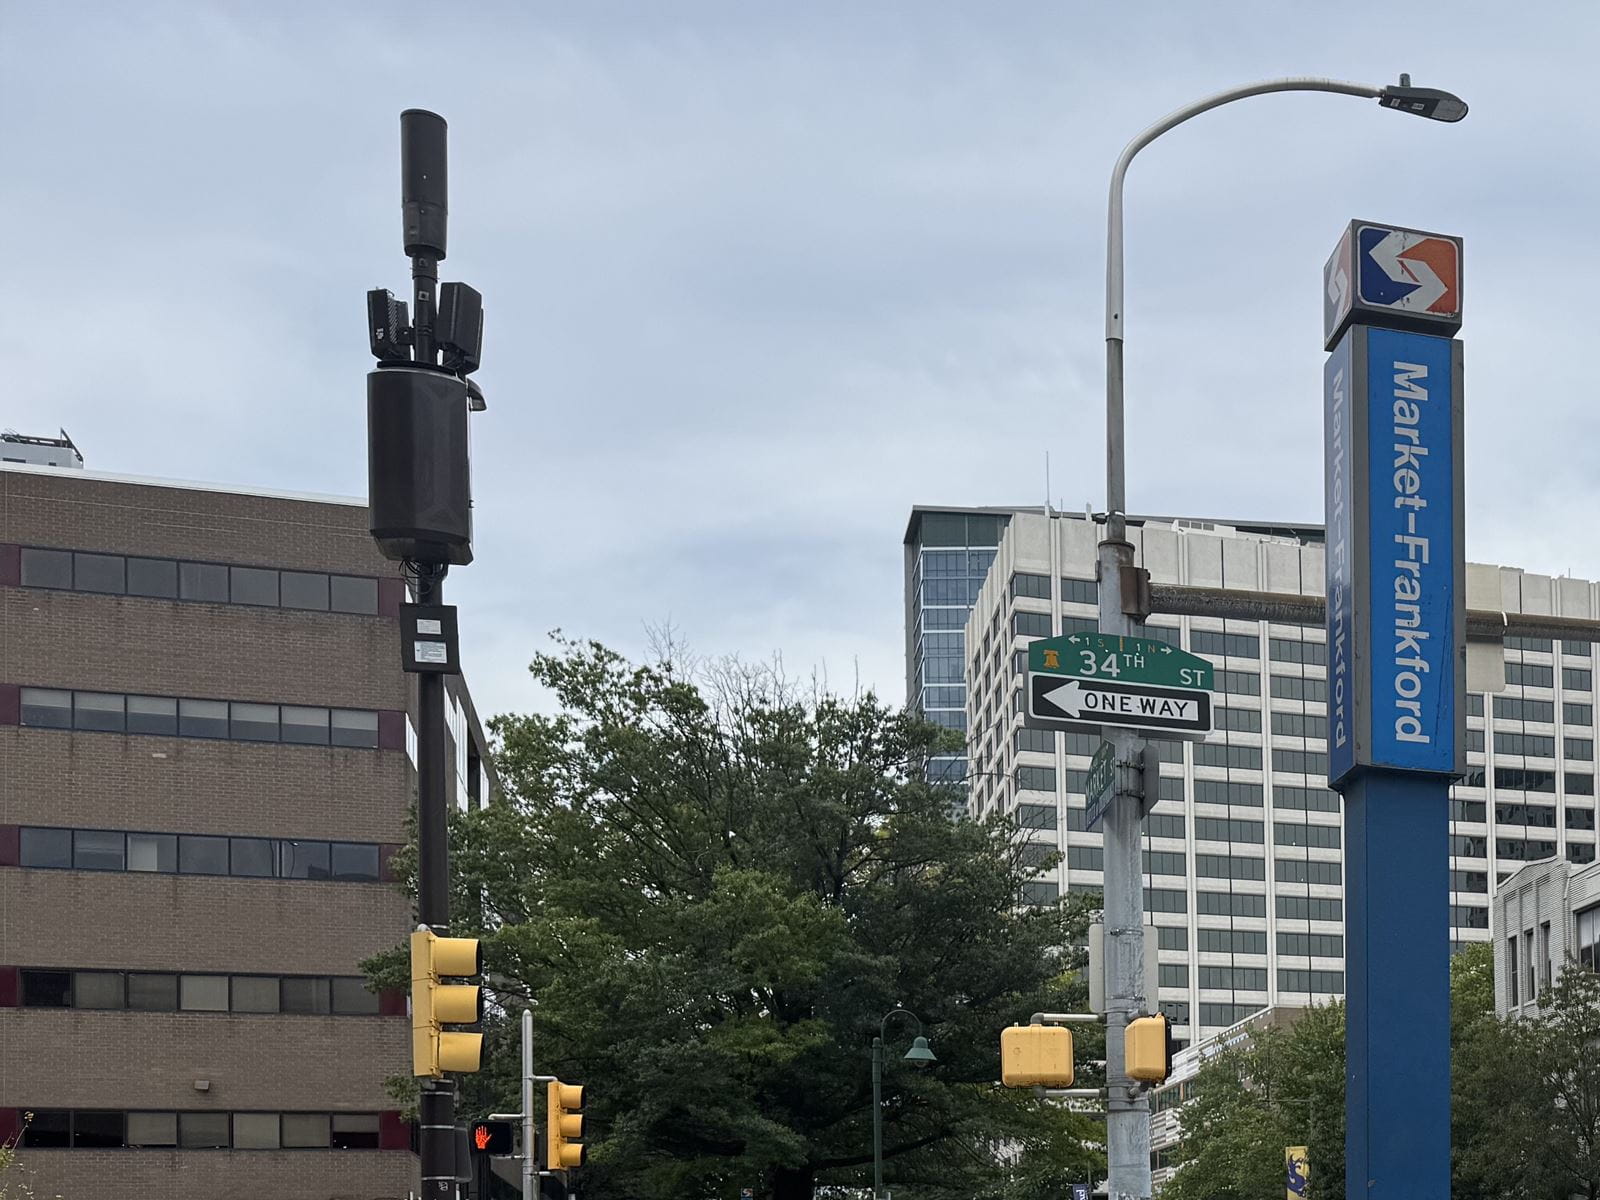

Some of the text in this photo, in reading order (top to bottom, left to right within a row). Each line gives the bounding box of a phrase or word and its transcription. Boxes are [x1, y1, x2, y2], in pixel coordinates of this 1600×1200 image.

[1332, 367, 1347, 749] Market-Frankford
[1393, 360, 1430, 744] Market-Frankford
[1079, 650, 1205, 687] 34TH ST
[1084, 692, 1189, 718] ONE WAY
